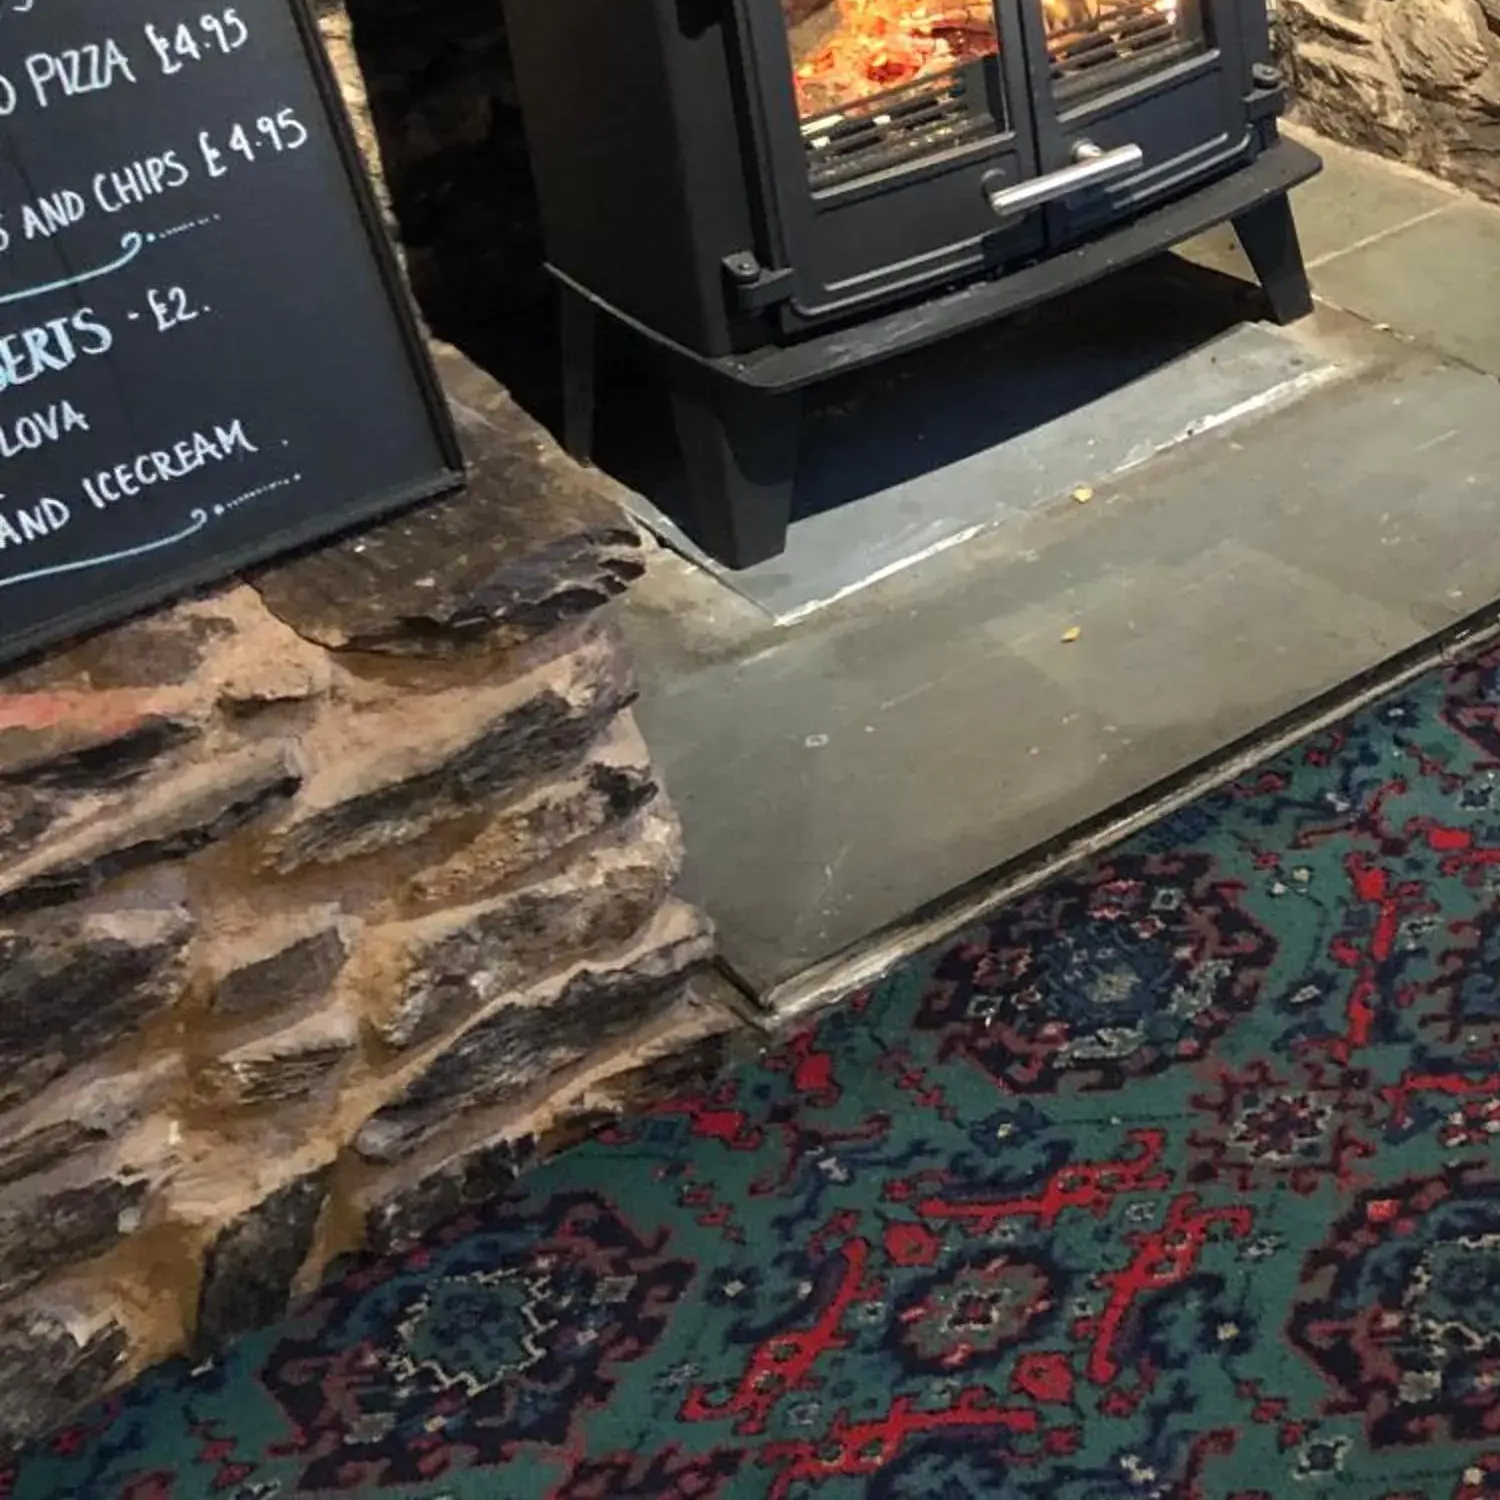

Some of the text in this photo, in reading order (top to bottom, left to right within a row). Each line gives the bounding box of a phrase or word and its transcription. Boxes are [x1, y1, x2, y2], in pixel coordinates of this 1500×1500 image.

[24, 38, 137, 108] PIZZA
[144, 7, 249, 75] £4.95
[21, 189, 86, 240] AND
[92, 150, 189, 213] CHIPS
[199, 107, 308, 178] £4.95
[81, 419, 260, 509] ICECREAM
